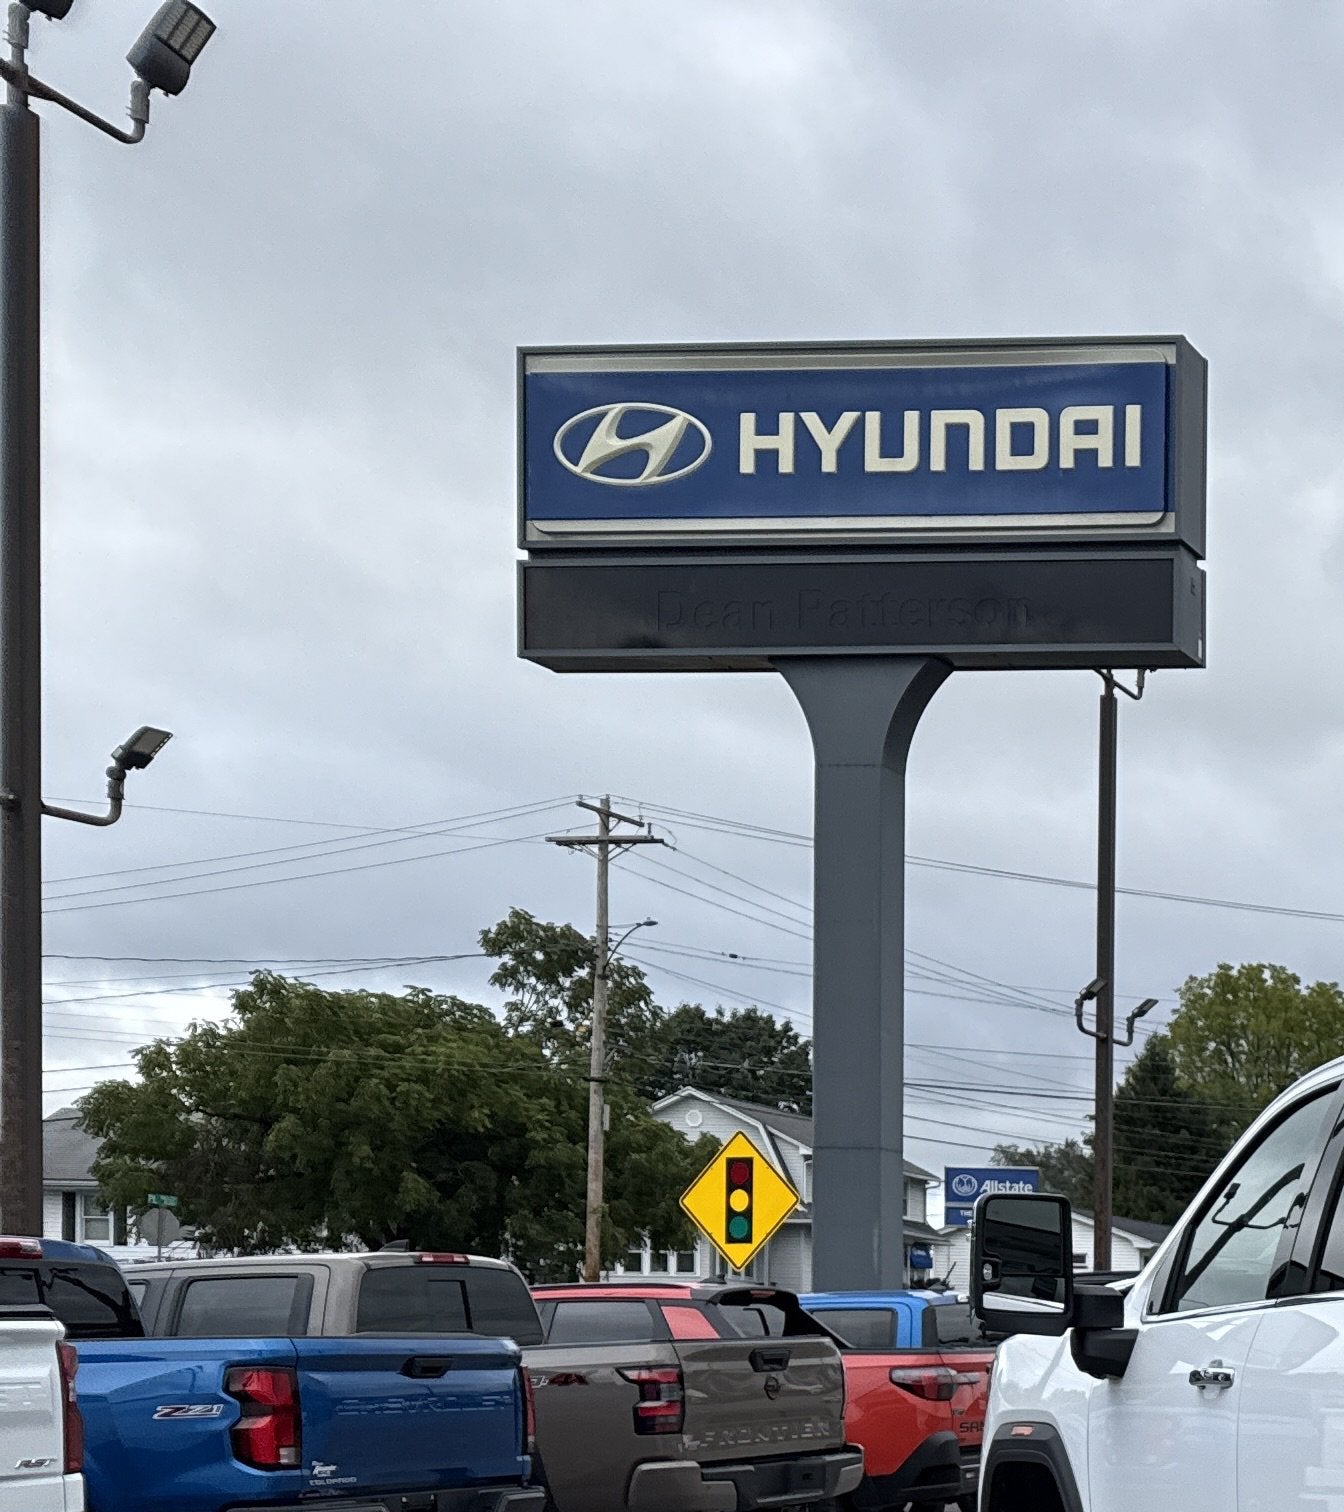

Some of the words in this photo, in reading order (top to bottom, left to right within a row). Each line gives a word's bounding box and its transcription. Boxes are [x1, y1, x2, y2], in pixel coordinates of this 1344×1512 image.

[739, 404, 1142, 474] HYUNDAI
[657, 589, 776, 632] Dean
[798, 587, 1031, 629] Patterson
[980, 1180, 1033, 1193] Allstate
